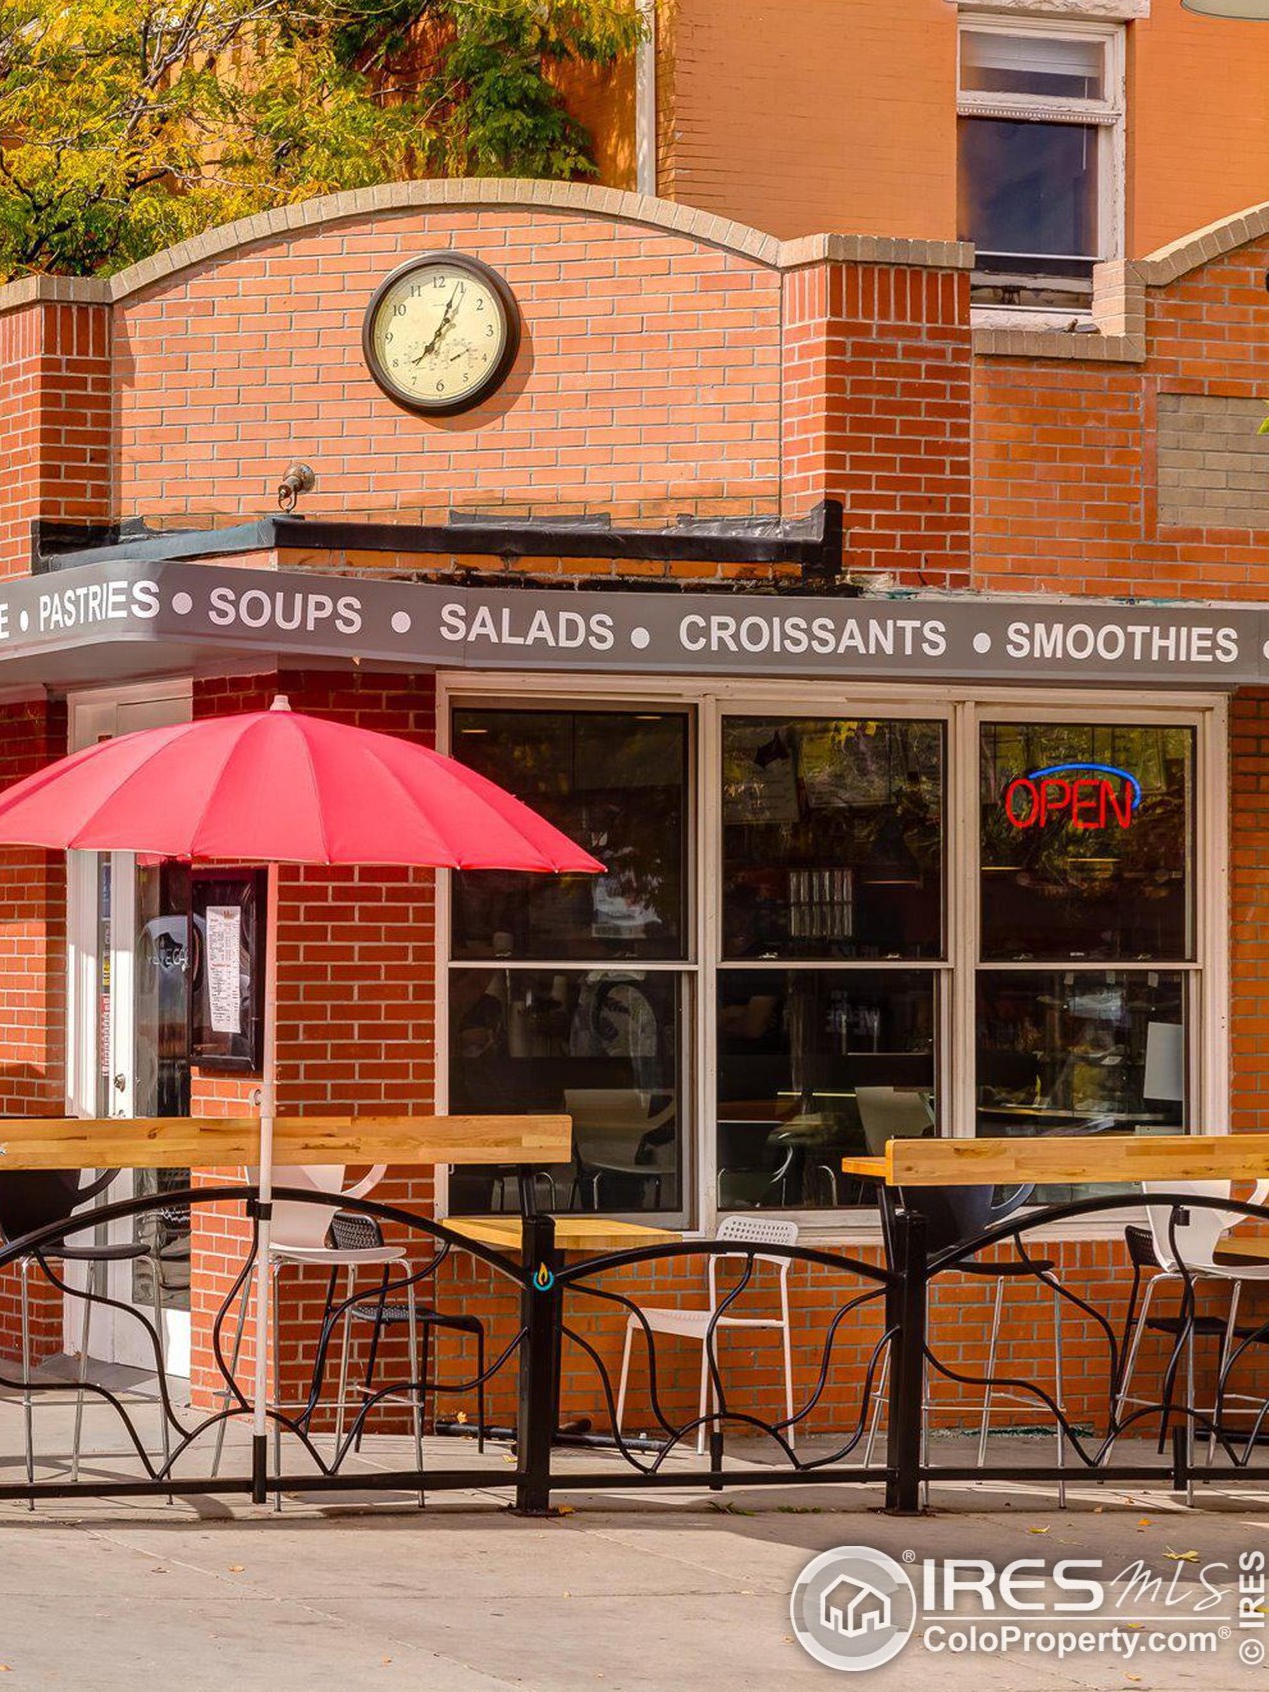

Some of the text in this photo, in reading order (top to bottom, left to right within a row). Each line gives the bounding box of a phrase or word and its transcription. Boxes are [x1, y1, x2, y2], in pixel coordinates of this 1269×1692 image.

[433, 276, 445, 288] 12
[460, 282, 466, 293] 1
[411, 286, 421, 297] 11
[393, 304, 406, 316] 10
[476, 299, 484, 310] 2
[486, 325, 493, 337] 3
[385, 333, 393, 344] 9
[481, 353, 488, 362] 4
[392, 359, 399, 368] 8
[411, 377, 417, 386] 7
[463, 373, 469, 382] 5
[436, 379, 444, 391] 6
[40, 580, 160, 632] PASTRIES
[208, 587, 362, 634] SOUPS
[440, 604, 614, 651] SALADS
[679, 614, 947, 657] CROISSANTS
[1006, 621, 1239, 663] SMOOTHIES
[1005, 778, 1132, 829] OPEN
